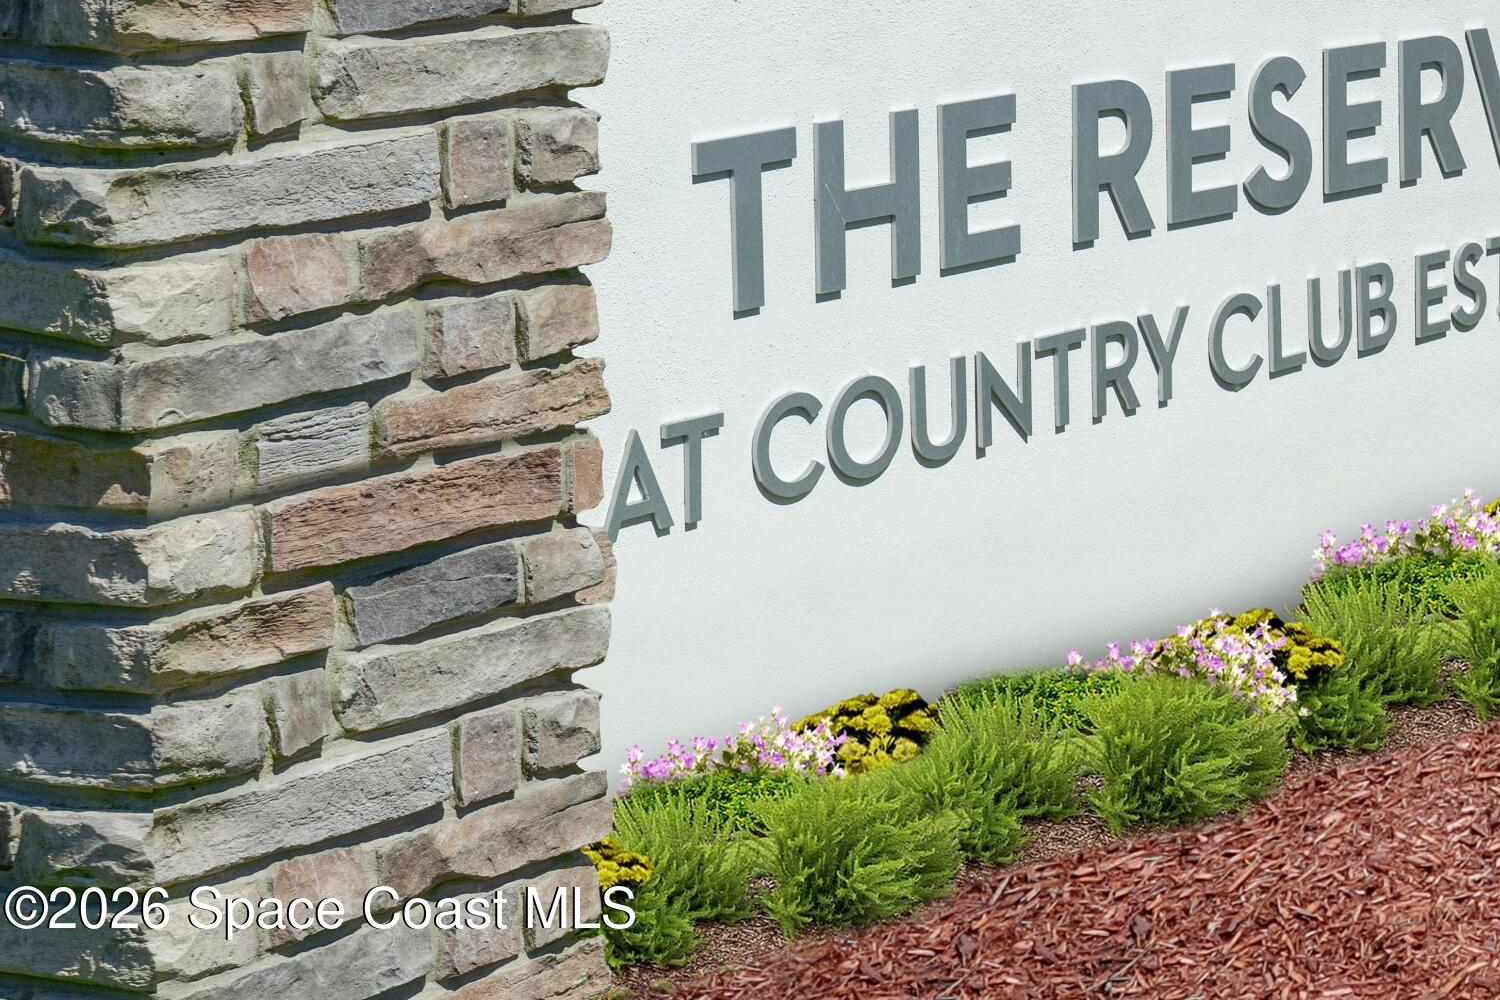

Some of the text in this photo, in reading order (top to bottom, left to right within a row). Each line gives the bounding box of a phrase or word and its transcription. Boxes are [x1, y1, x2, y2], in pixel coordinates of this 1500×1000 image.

[691, 93, 1022, 320] THE
[604, 411, 725, 543] AT
[751, 305, 1190, 505] COUNTRY
[1207, 262, 1398, 392] CLUB
